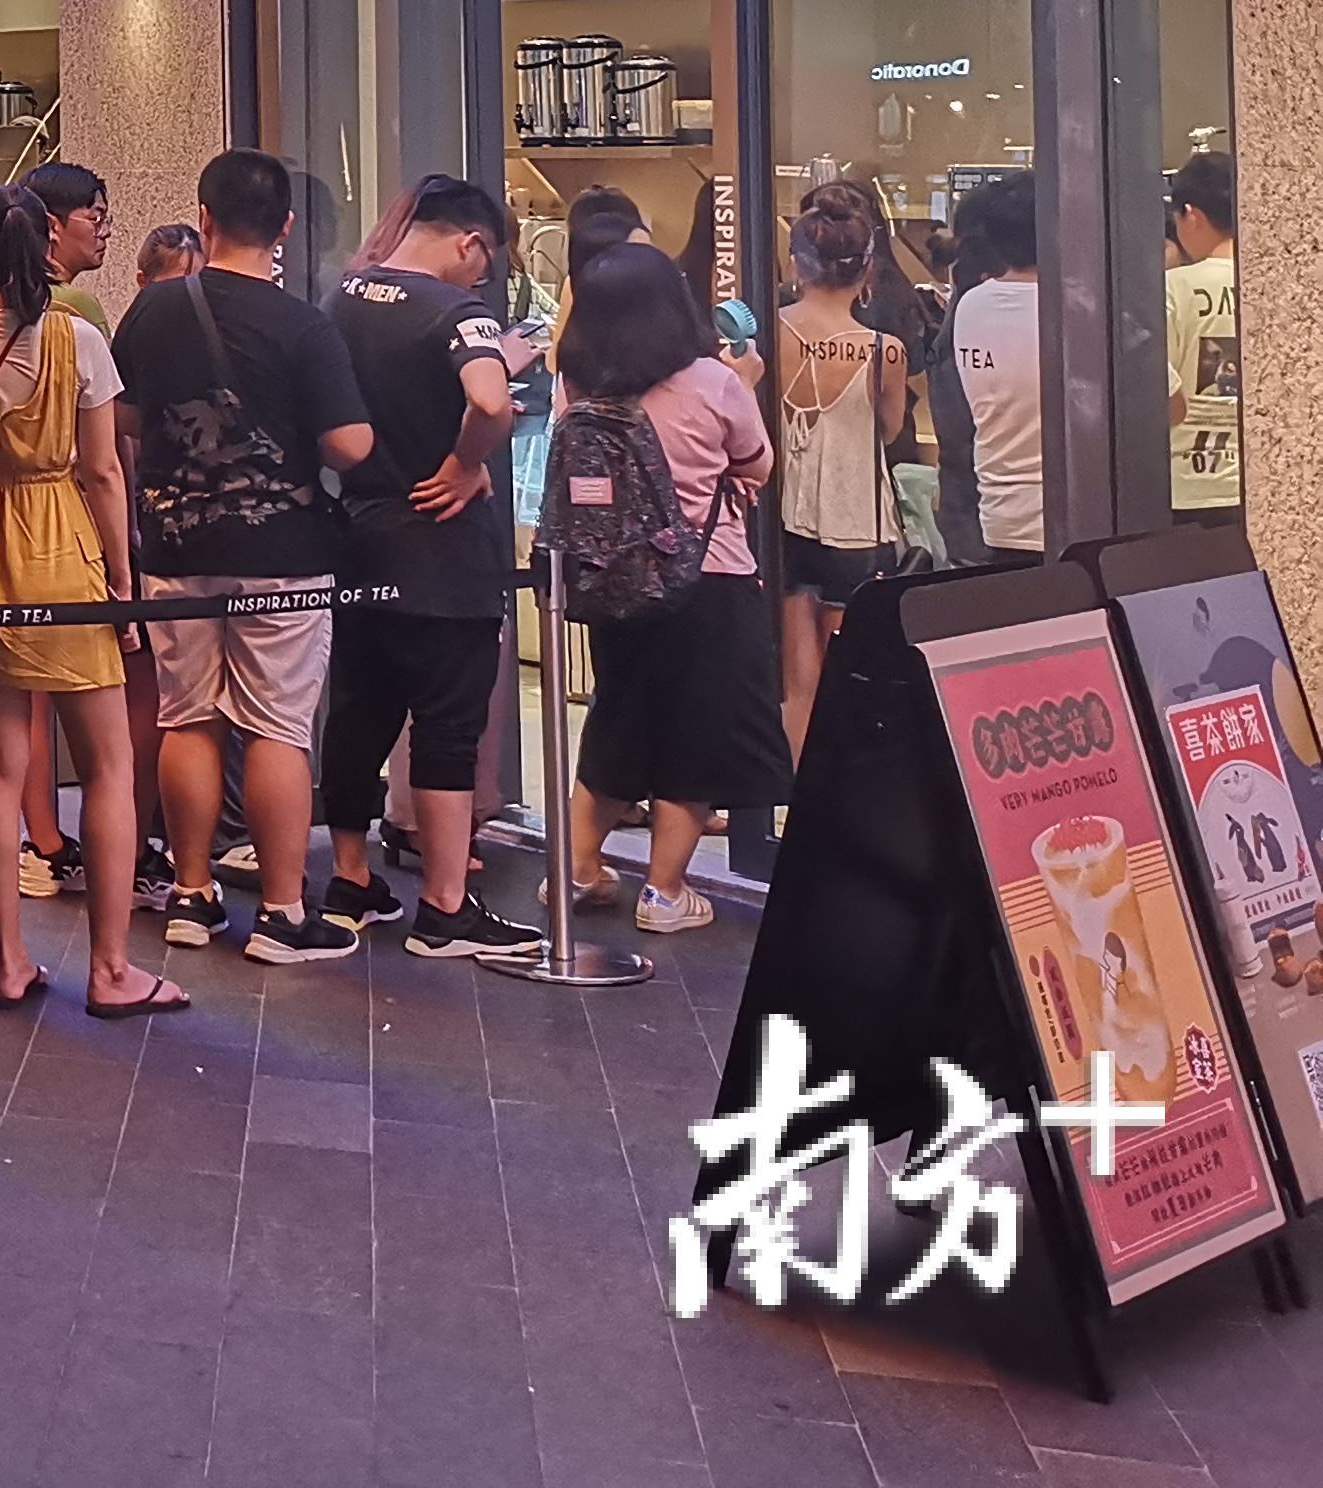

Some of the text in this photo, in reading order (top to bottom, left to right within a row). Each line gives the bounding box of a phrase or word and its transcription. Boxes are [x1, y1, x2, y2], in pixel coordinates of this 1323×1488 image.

[713, 175, 736, 304] INSPIRAT
[959, 348, 995, 369] TEA
[227, 585, 400, 612] INSPIRATION OF TEA
[22, 609, 53, 623] TEA
[1001, 767, 1118, 810] VERY MANGO POMELO
